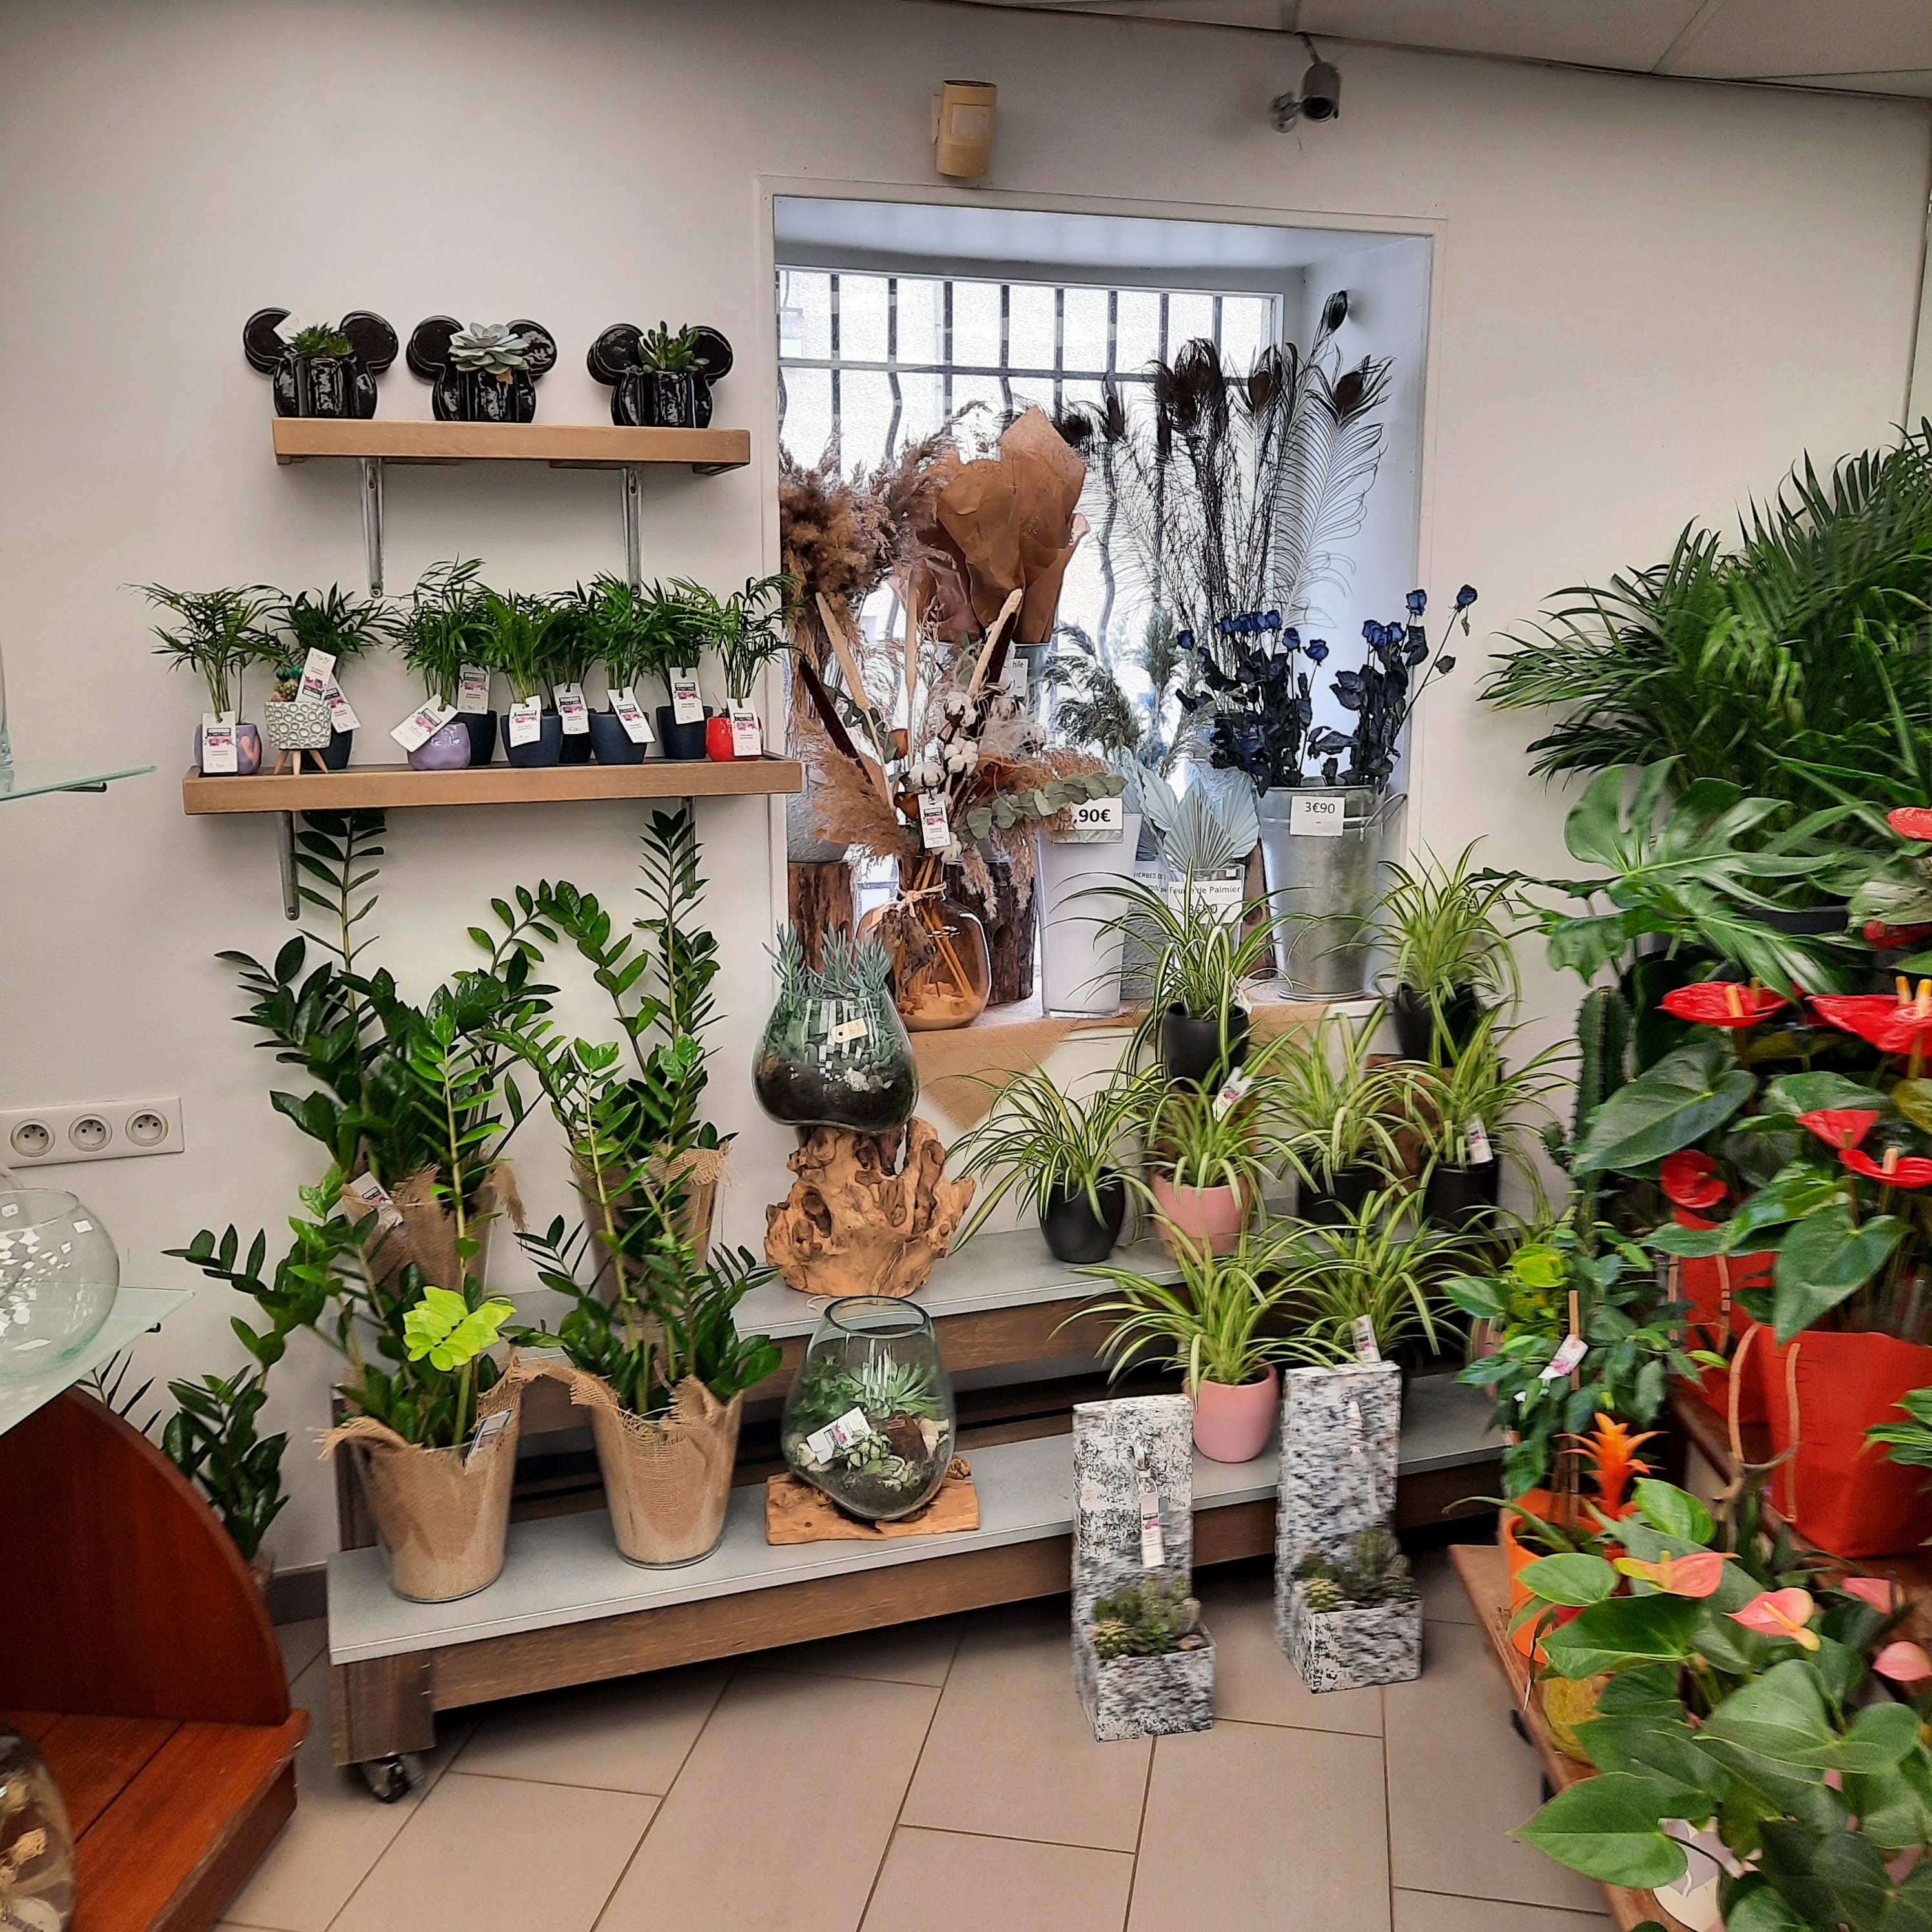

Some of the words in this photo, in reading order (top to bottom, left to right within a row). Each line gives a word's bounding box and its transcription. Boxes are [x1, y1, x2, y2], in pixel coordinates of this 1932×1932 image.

[1305, 802, 1335, 814] 3€90
[1073, 808, 1111, 824] ,90€
[1209, 885, 1240, 894] Palmier
